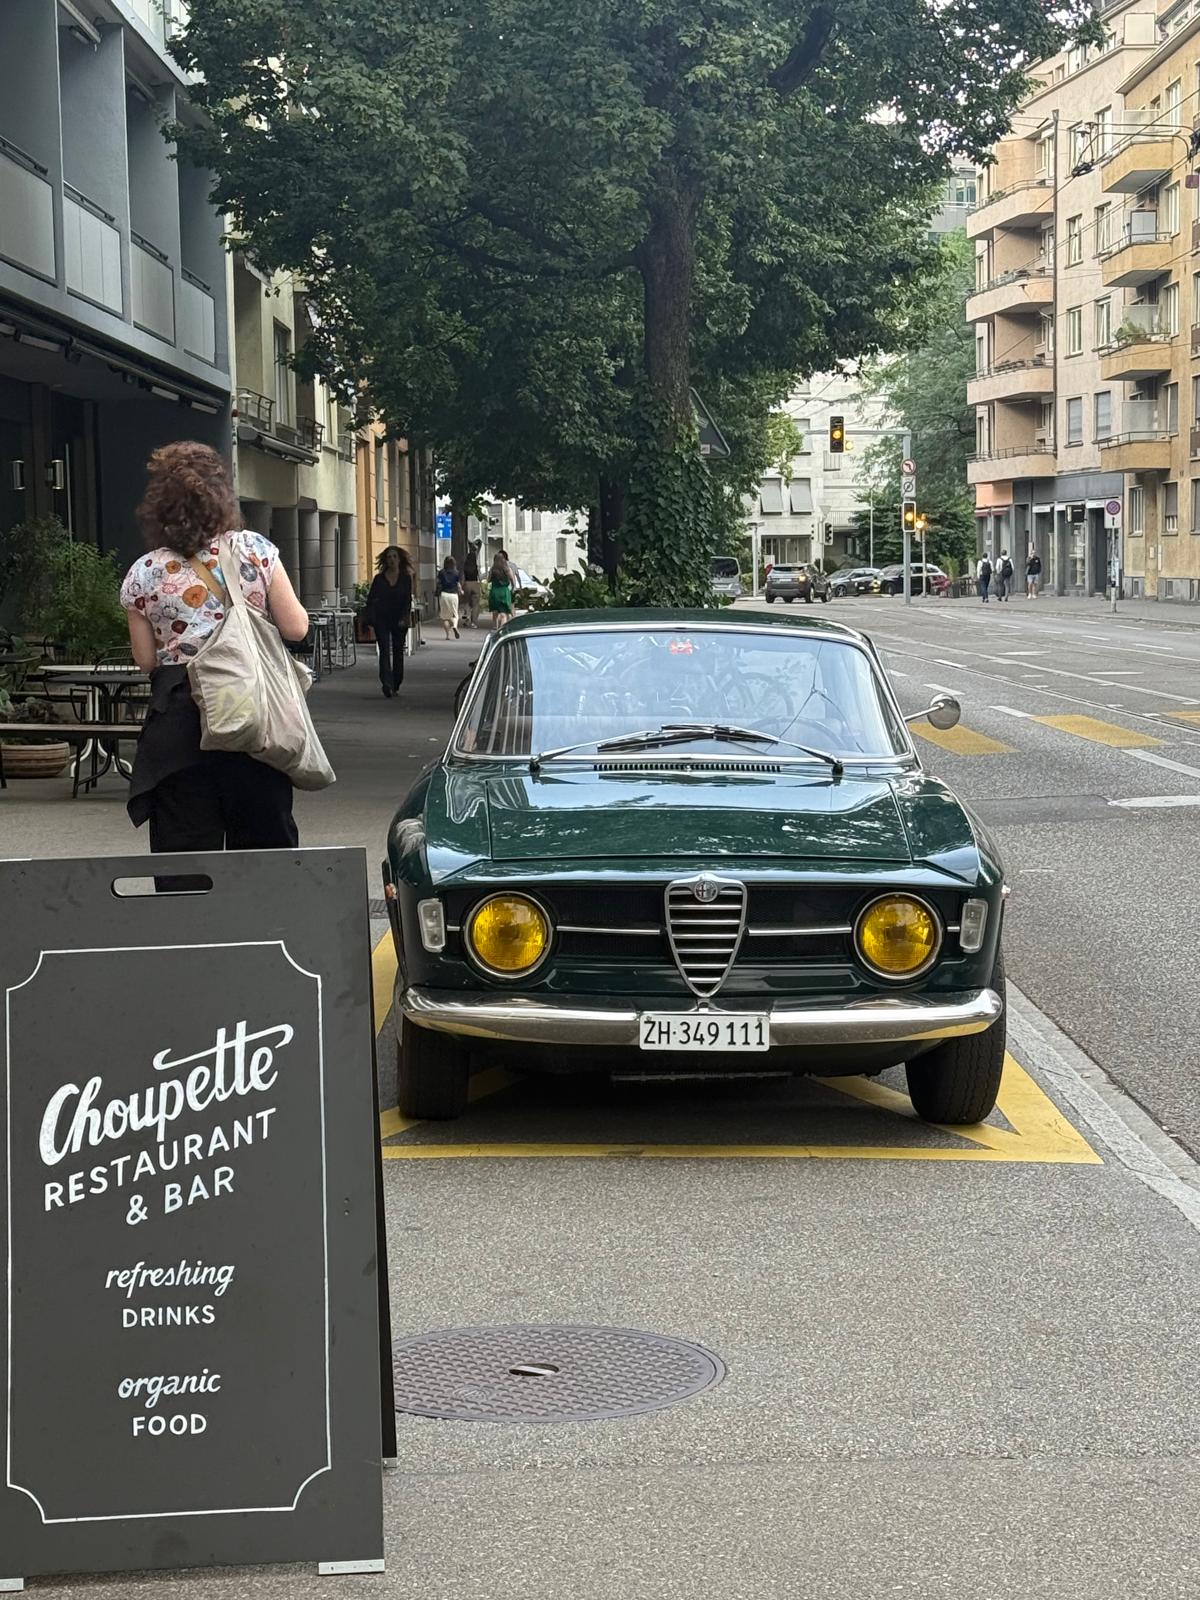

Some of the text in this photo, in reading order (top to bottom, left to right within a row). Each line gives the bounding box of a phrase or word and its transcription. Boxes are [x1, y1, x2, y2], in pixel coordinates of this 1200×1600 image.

[38, 1020, 294, 1166] Choupette
[44, 1107, 277, 1212] RESTAURANT
[125, 1165, 235, 1226] & BAR
[104, 1259, 235, 1299] refreshing
[122, 1304, 216, 1328] DRINKS
[117, 1368, 221, 1409] organic
[132, 1413, 207, 1437] FOOD
